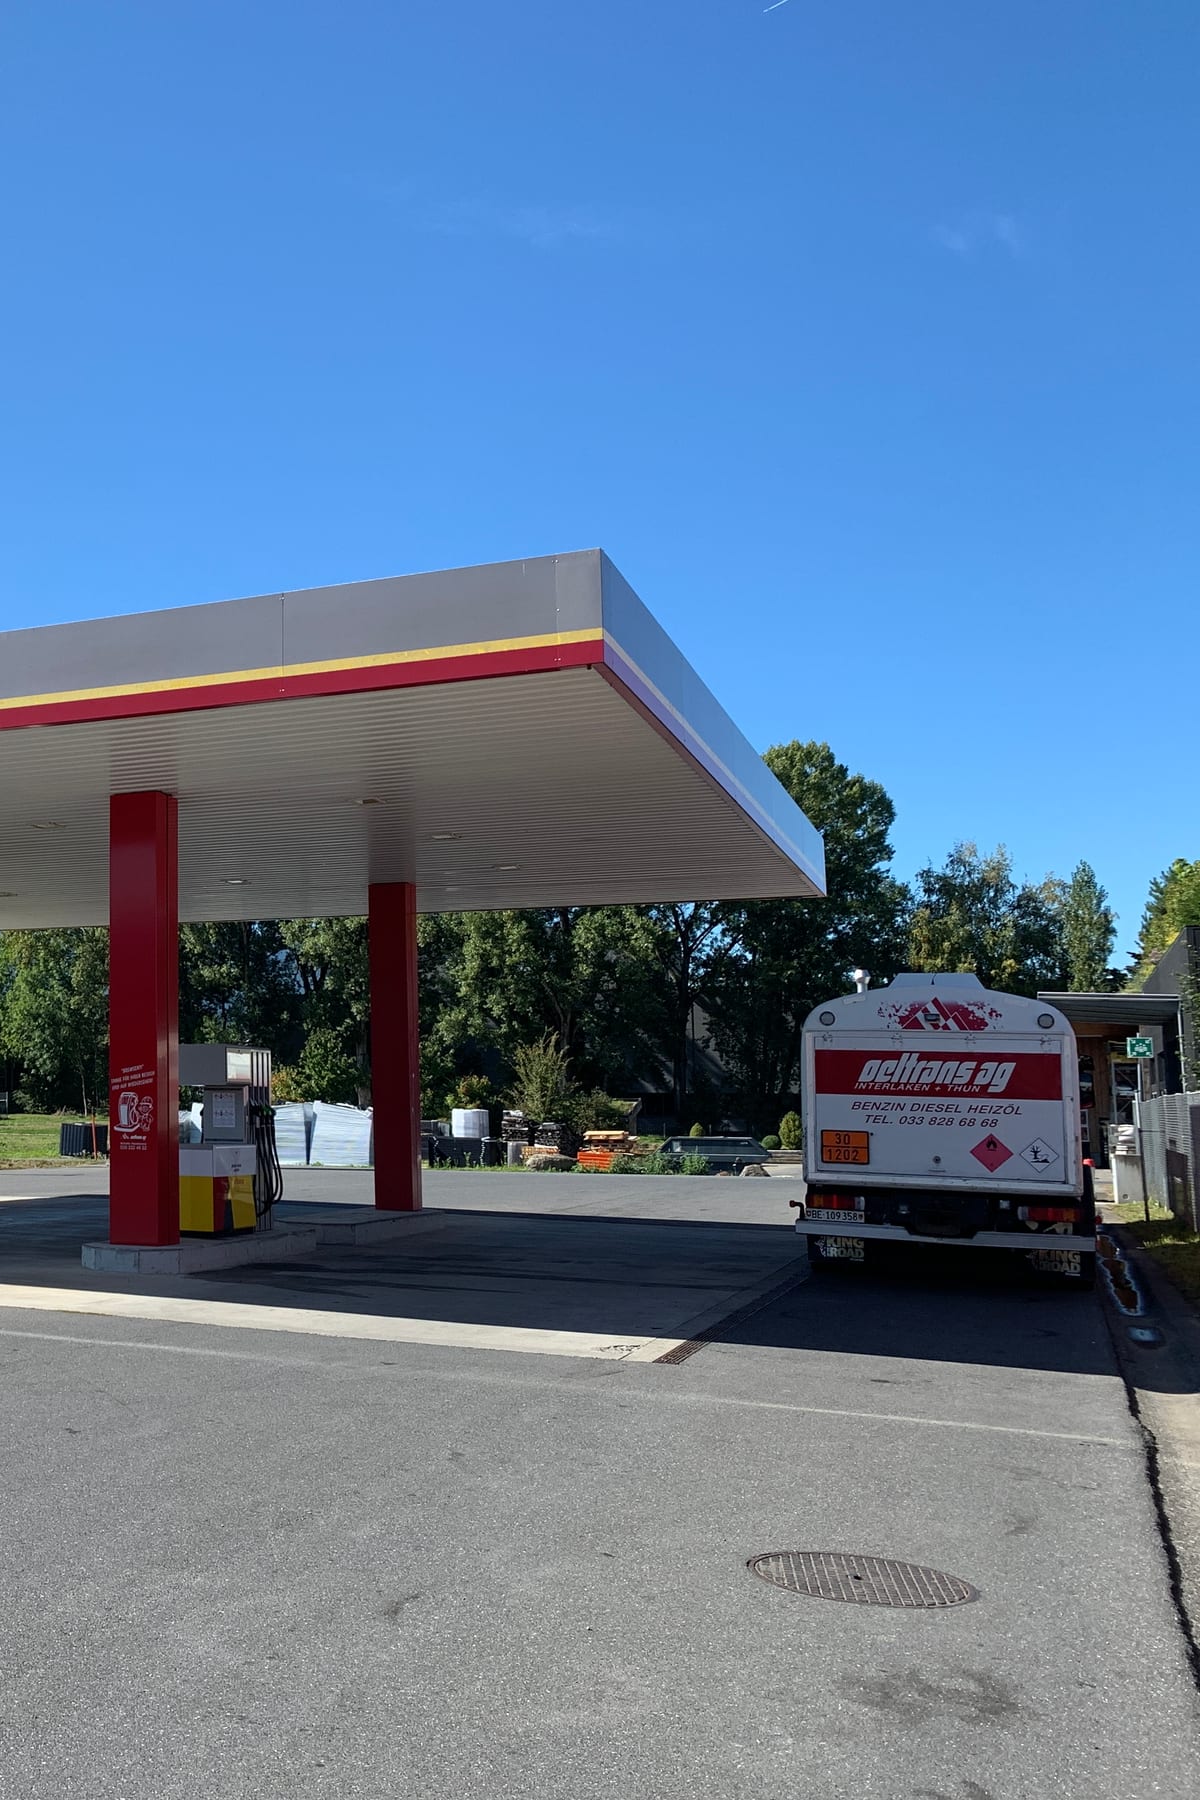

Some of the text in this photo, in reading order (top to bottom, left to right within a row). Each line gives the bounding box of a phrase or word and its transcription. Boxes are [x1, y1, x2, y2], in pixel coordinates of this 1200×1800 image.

[973, 1061, 1017, 1093] ag
[854, 1082, 931, 1092] INTERLAKEN
[947, 1084, 981, 1093] THUN
[851, 1101, 1023, 1115] BENZIN DIESEL HEIZÖL
[864, 1114, 998, 1128] TEL. 033 828 68 68
[835, 1133, 850, 1145] 30
[827, 1148, 859, 1161] 1202
